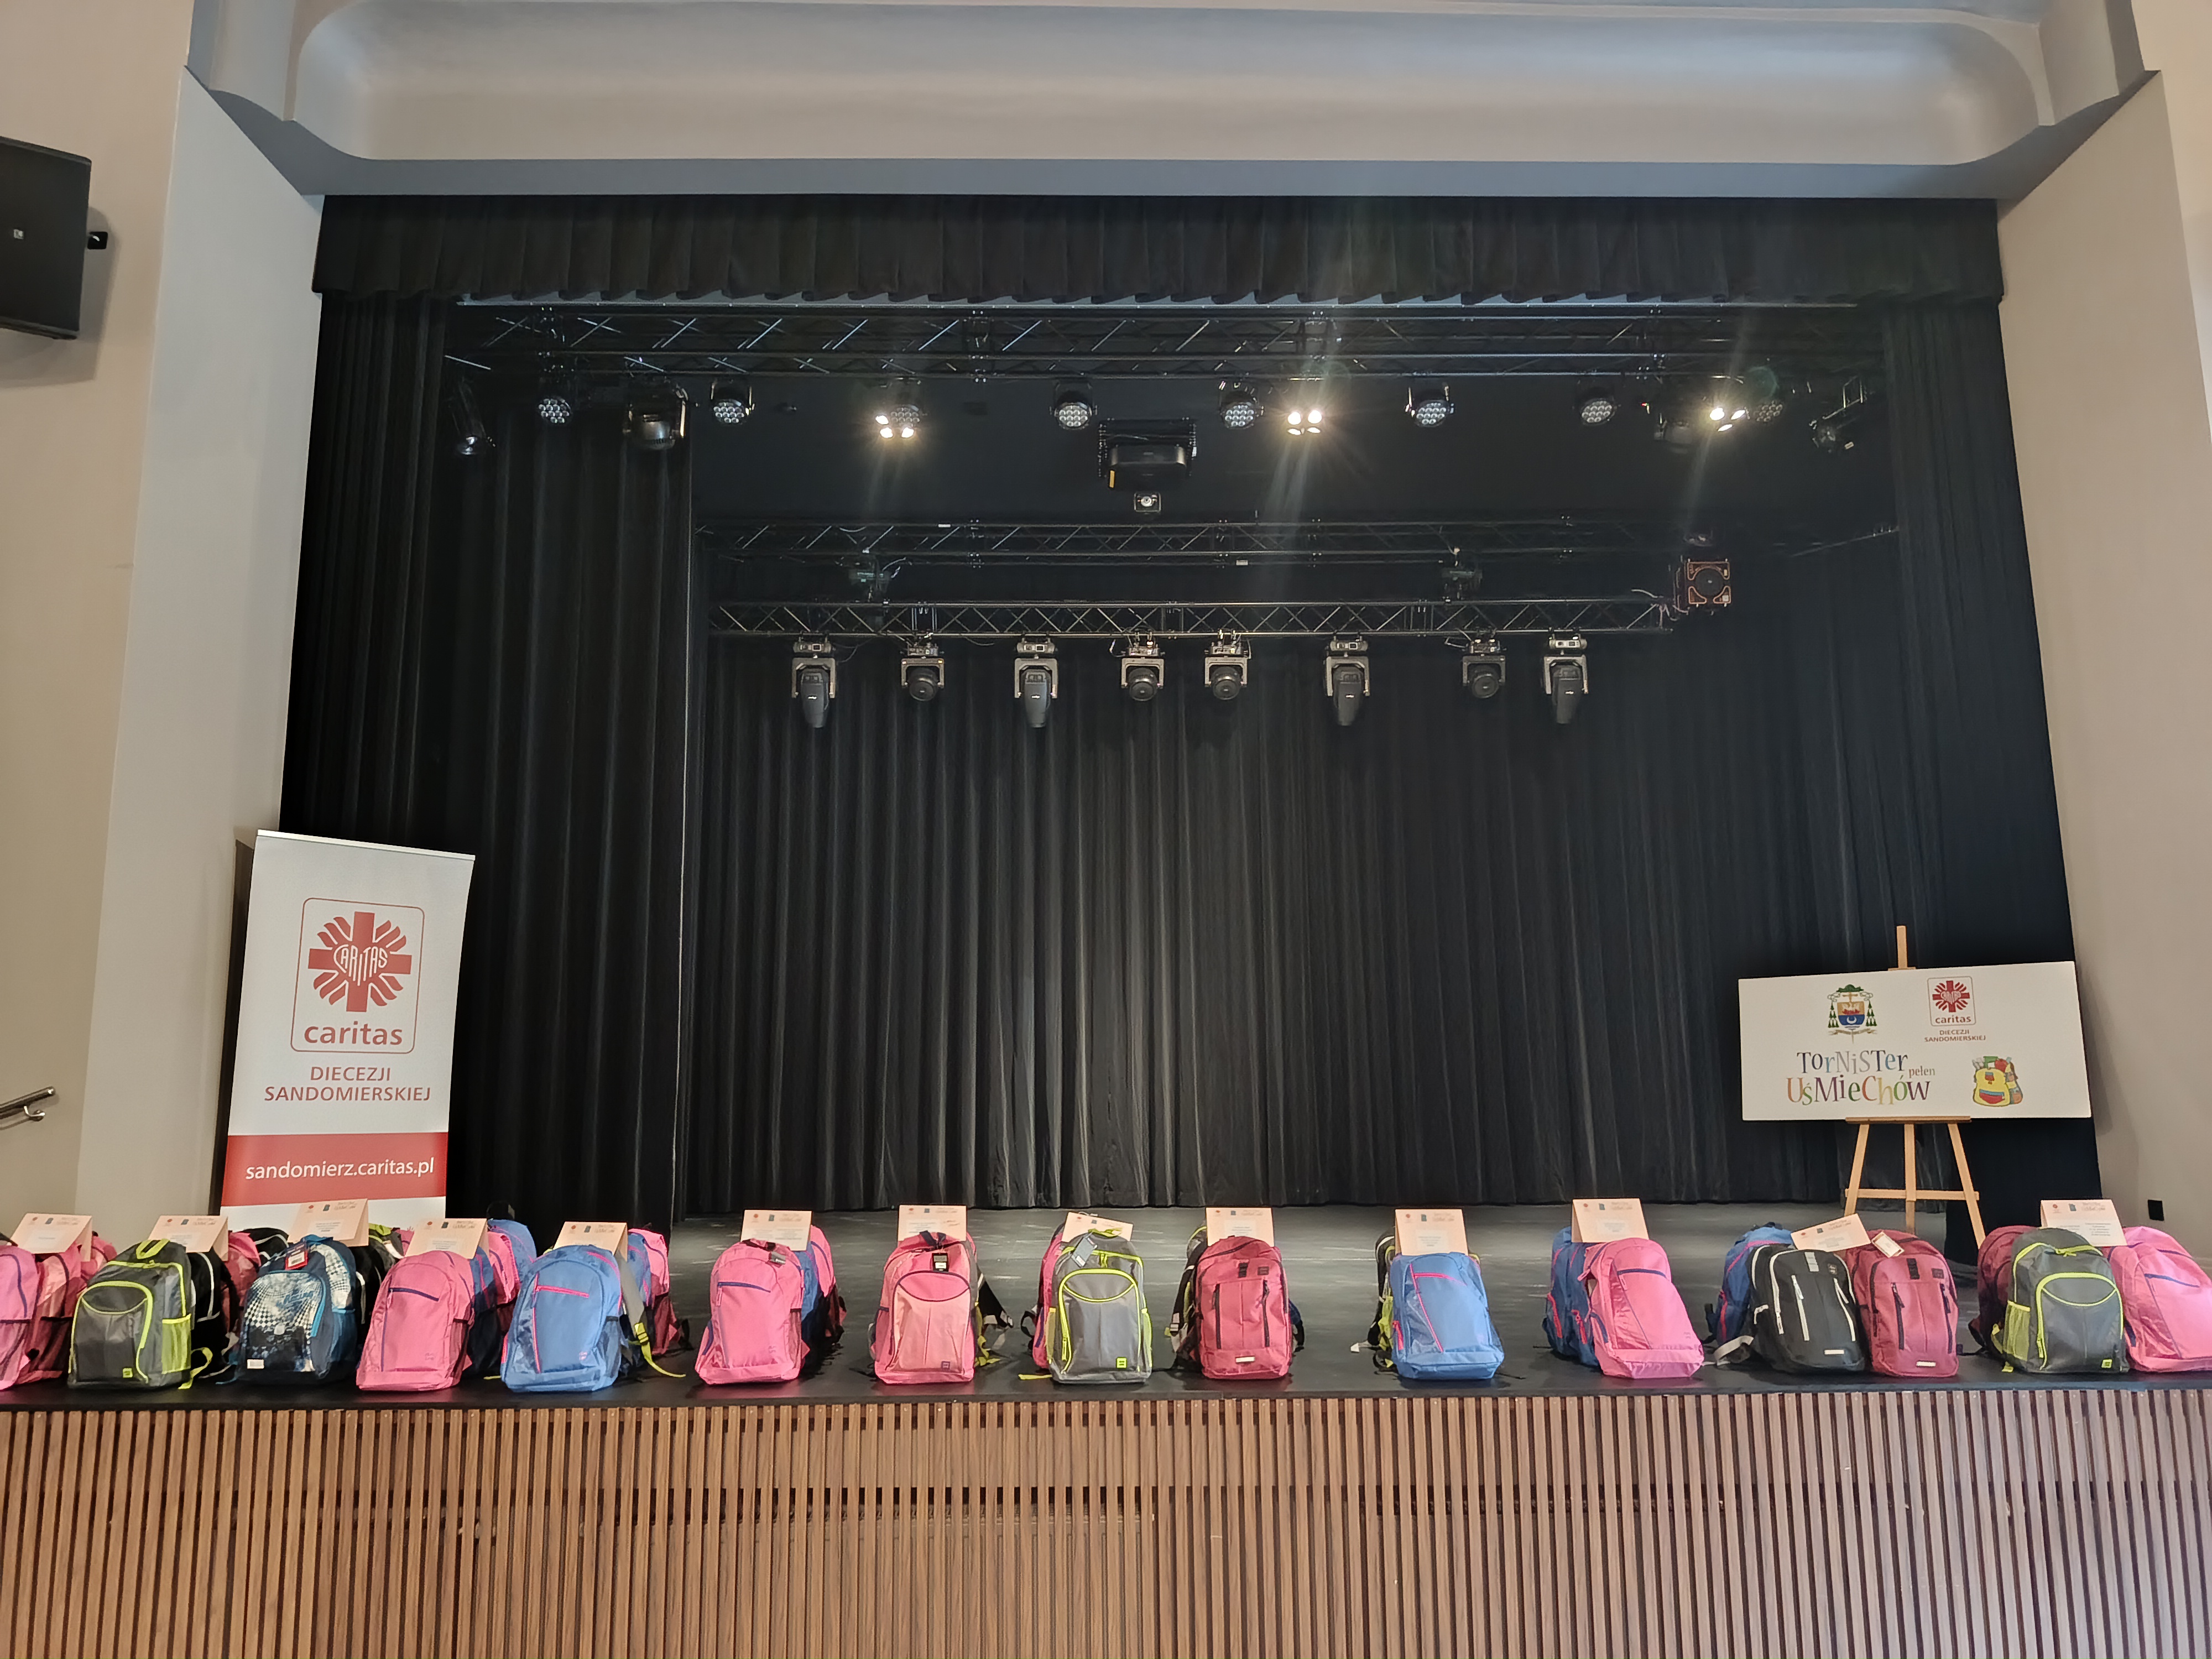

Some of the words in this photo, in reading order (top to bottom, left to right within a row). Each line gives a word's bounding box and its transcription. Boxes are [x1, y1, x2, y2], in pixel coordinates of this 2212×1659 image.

[333, 944, 388, 986] CARITAS
[1935, 1015, 1971, 1024] caritas
[304, 1021, 403, 1045] caritas
[310, 1066, 390, 1082] DIECEZJI
[264, 1087, 431, 1102] SANDOMIERSKIEJ
[245, 1157, 435, 1180] sandomierz.caritas.pl
